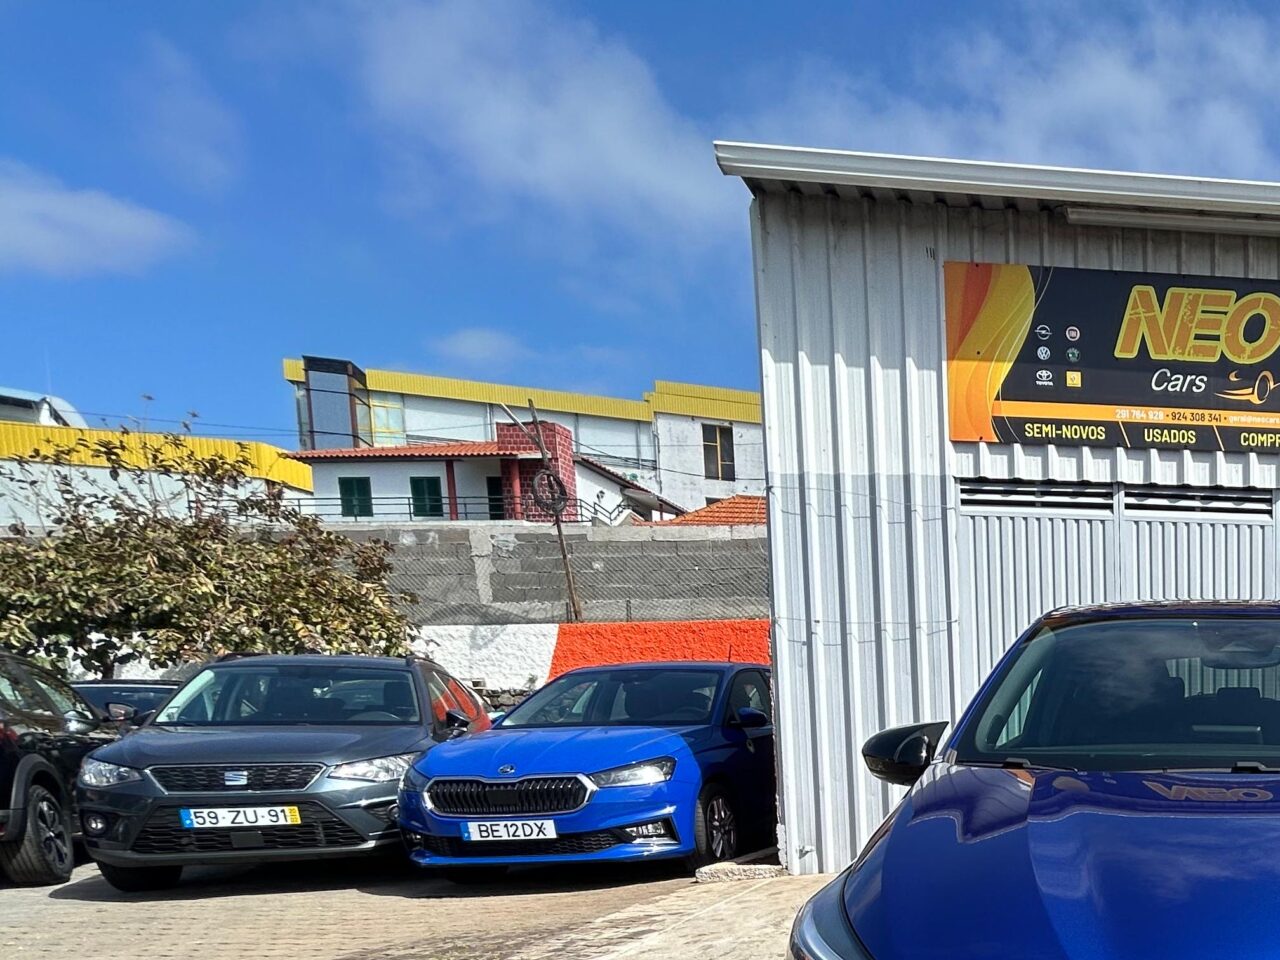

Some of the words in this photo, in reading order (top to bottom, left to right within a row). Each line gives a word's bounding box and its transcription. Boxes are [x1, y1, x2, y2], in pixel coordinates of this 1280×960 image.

[1151, 368, 1208, 393] Cars
[1171, 411, 1187, 421] 924
[1190, 412, 1205, 422] 308
[1208, 413, 1222, 423] 341
[1024, 423, 1106, 440] SEMI-NOVOS
[1144, 428, 1196, 444] USADOS
